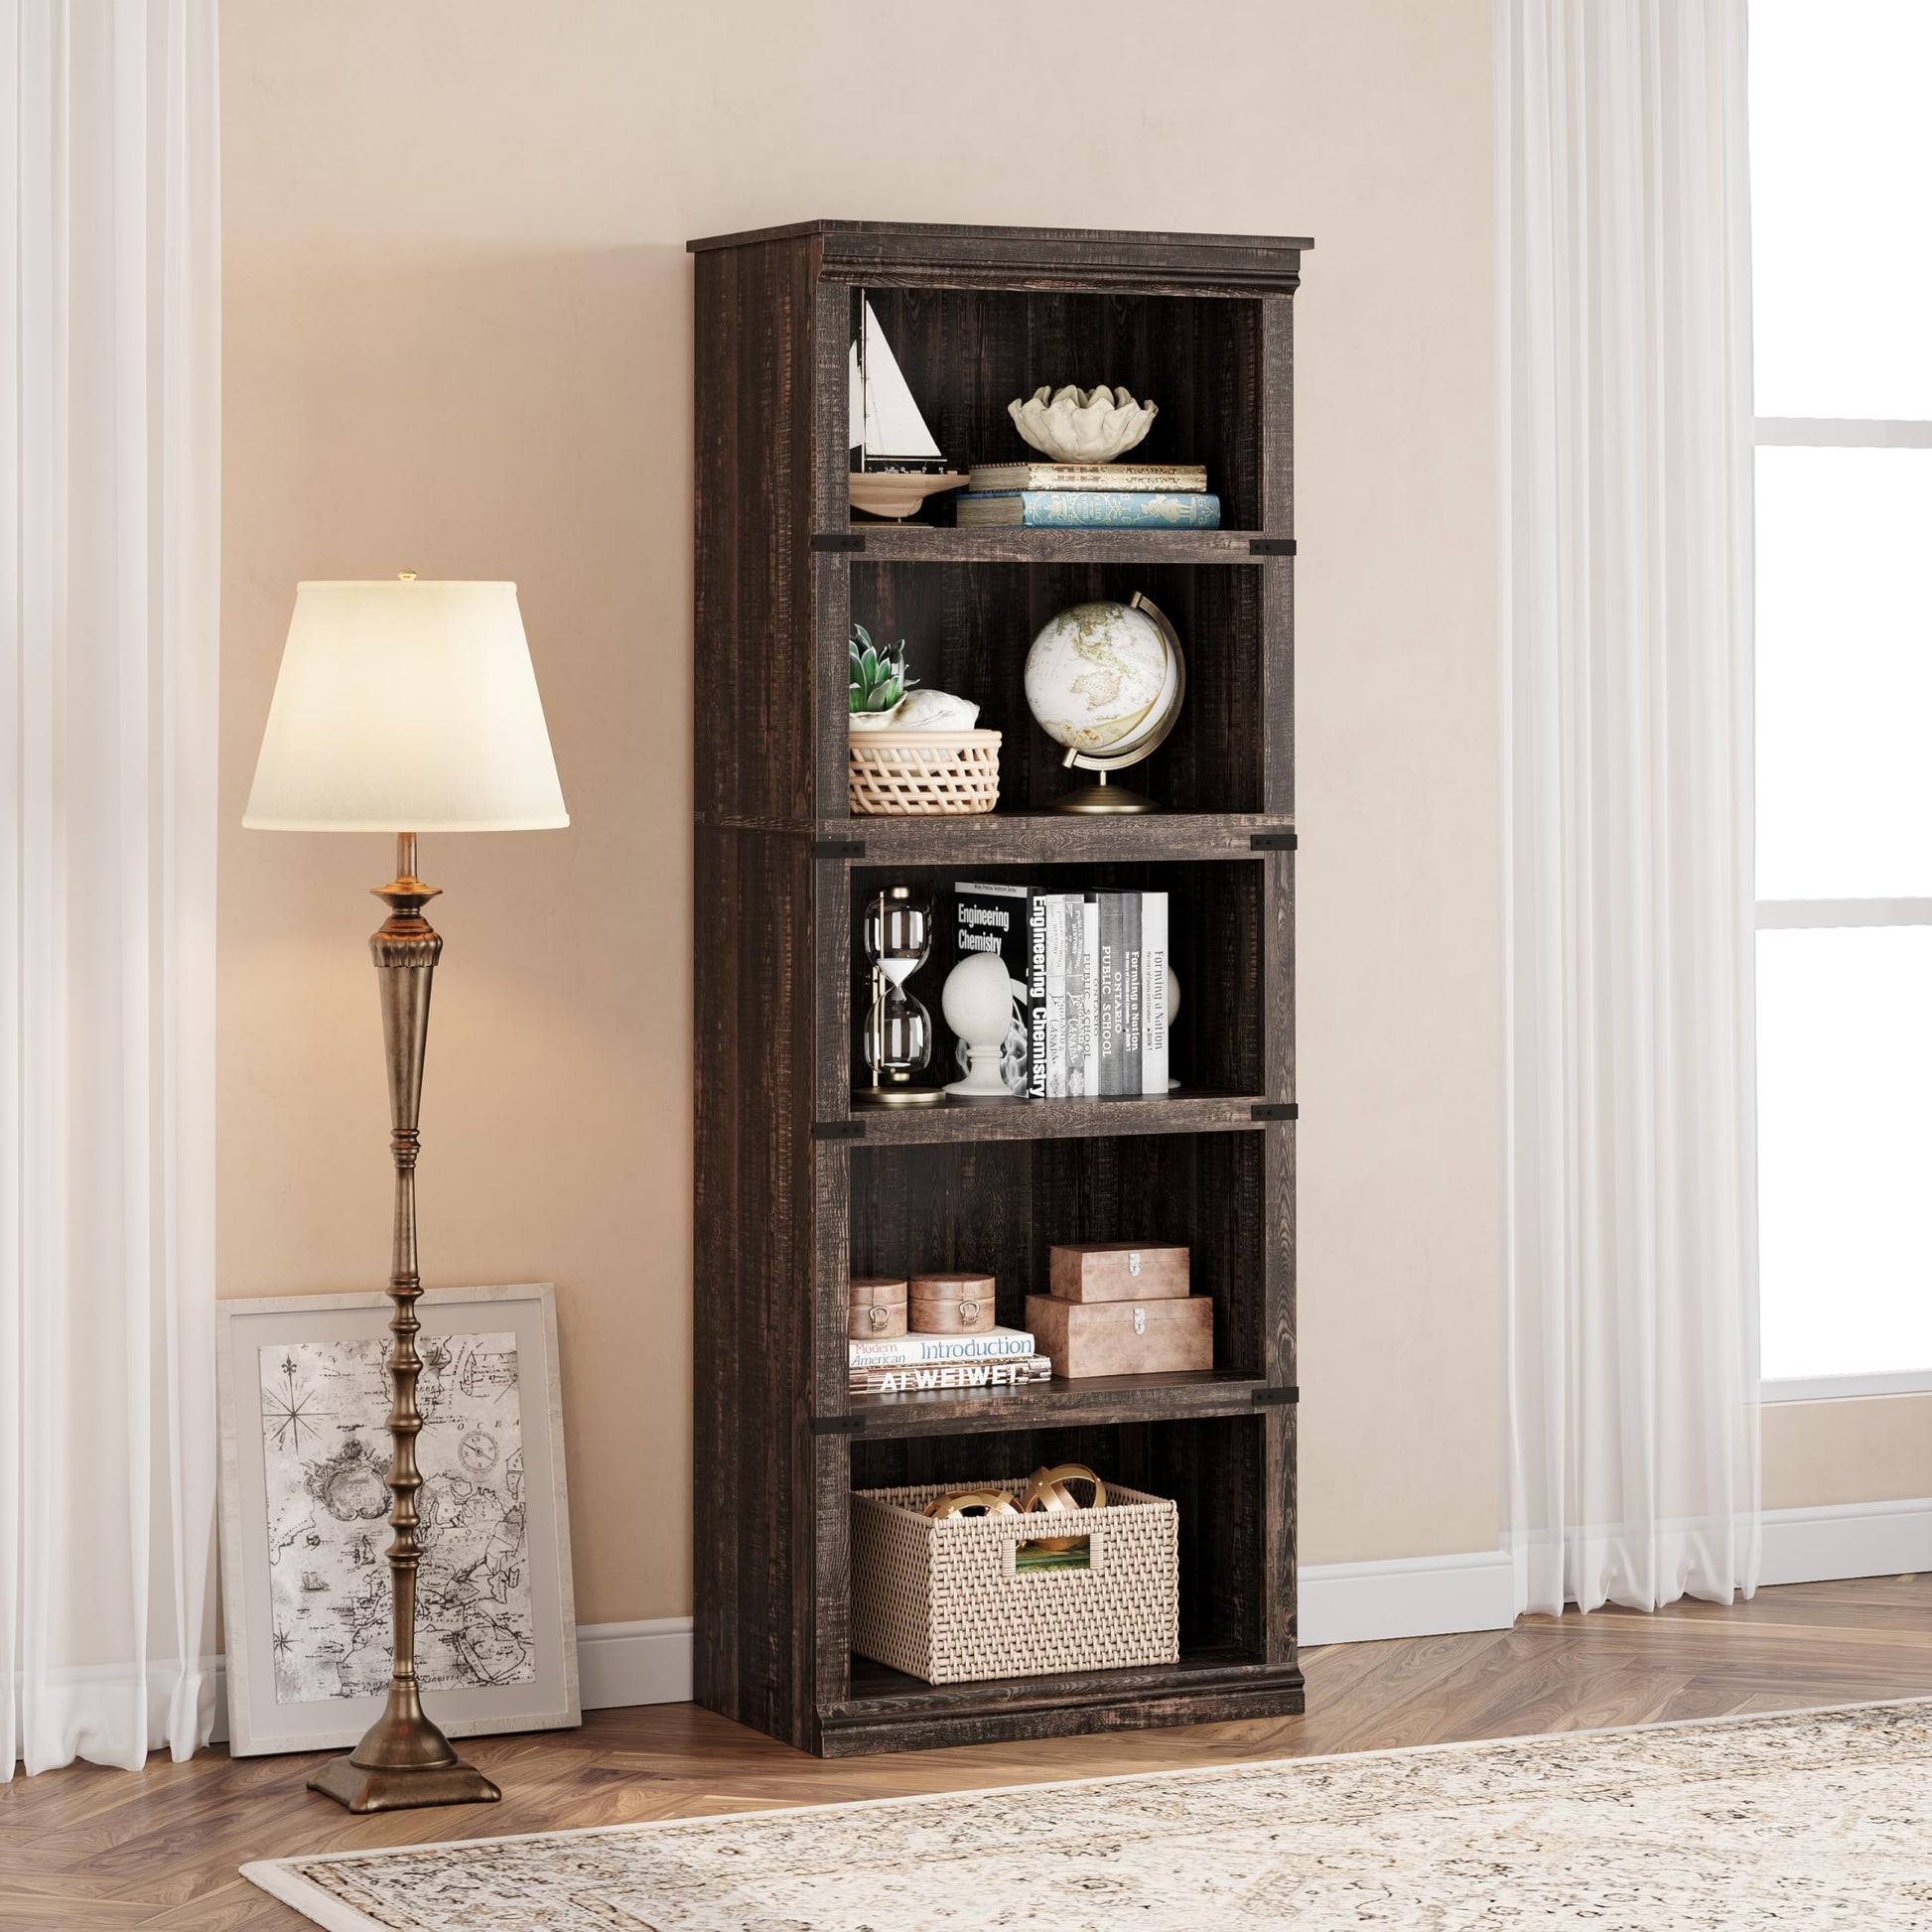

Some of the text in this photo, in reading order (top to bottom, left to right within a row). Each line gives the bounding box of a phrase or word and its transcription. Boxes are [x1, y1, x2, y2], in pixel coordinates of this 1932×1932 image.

[958, 903, 1010, 932] Engineering
[958, 928, 1002, 956] Chemistry
[1130, 951, 1140, 1001] Forming
[1153, 951, 1165, 1000] Forming
[1030, 896, 1046, 1098] Engineering Chemistry
[1102, 946, 1111, 1057] PUBLIC SCHOOL
[1131, 1013, 1140, 1051] Nation
[1154, 1012, 1165, 1050] Nation
[851, 1353, 906, 1367] American
[855, 1343, 897, 1355] Modern
[921, 1336, 1032, 1360] Introduction
[880, 1364, 1018, 1391] AI WEIWEI
